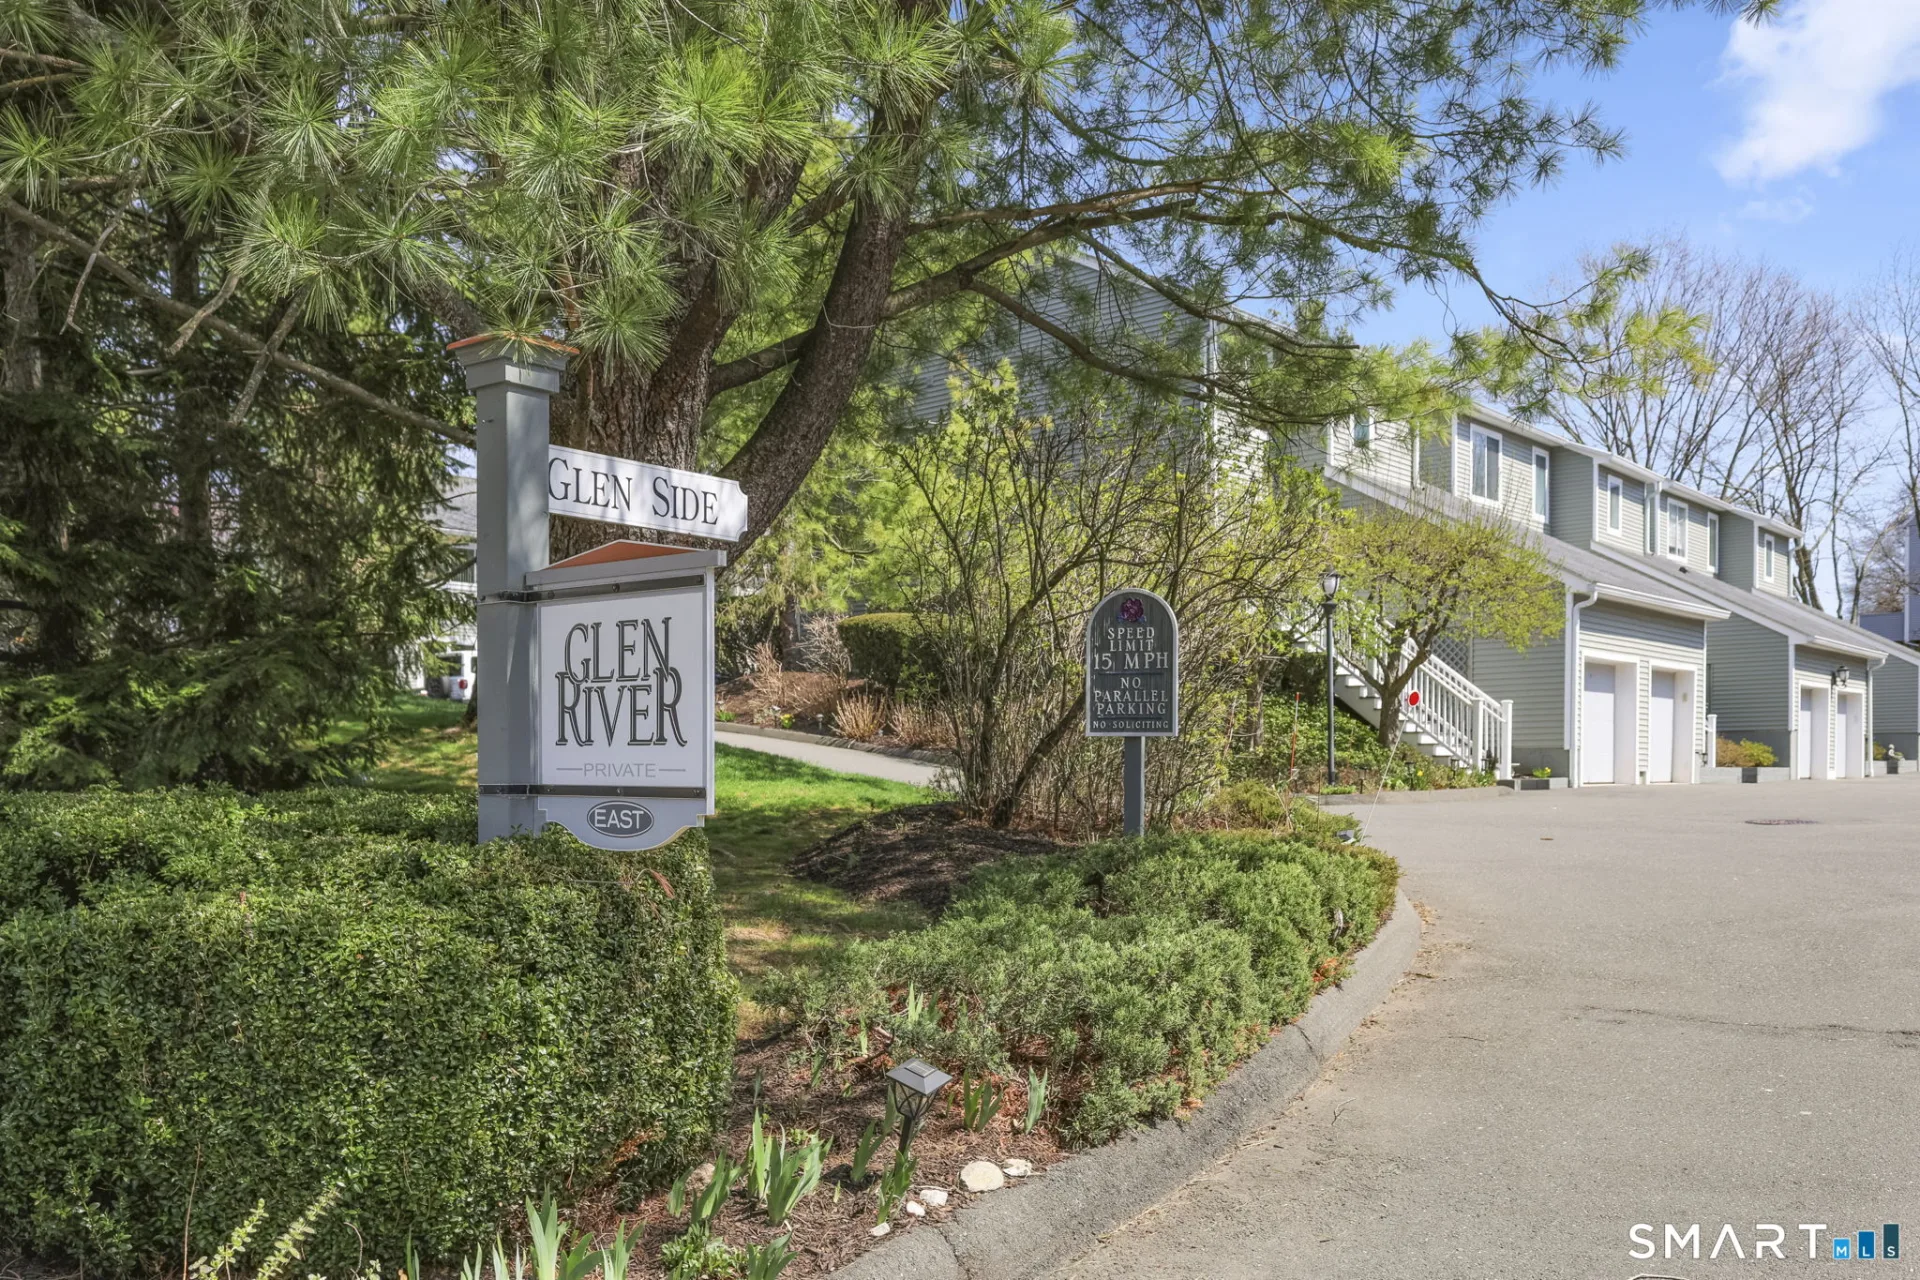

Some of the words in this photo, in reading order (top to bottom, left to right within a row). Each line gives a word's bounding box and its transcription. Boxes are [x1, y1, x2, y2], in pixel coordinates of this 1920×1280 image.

[548, 457, 632, 512] GLEN
[652, 476, 718, 526] SIDE
[1107, 627, 1155, 639] SPEED
[565, 617, 672, 684] GLEN
[1110, 640, 1154, 652] LIMIT
[1094, 653, 1112, 670] 15
[1123, 652, 1169, 670] MPH
[1120, 677, 1141, 689] NO
[1094, 690, 1168, 702] PARALLEL
[555, 666, 688, 747] RIVER
[1096, 703, 1166, 715] PARKING
[1093, 721, 1106, 729] NO
[1112, 721, 1169, 729] SOLICITING
[583, 763, 656, 777] PRIVATE
[593, 809, 644, 830] EAST
